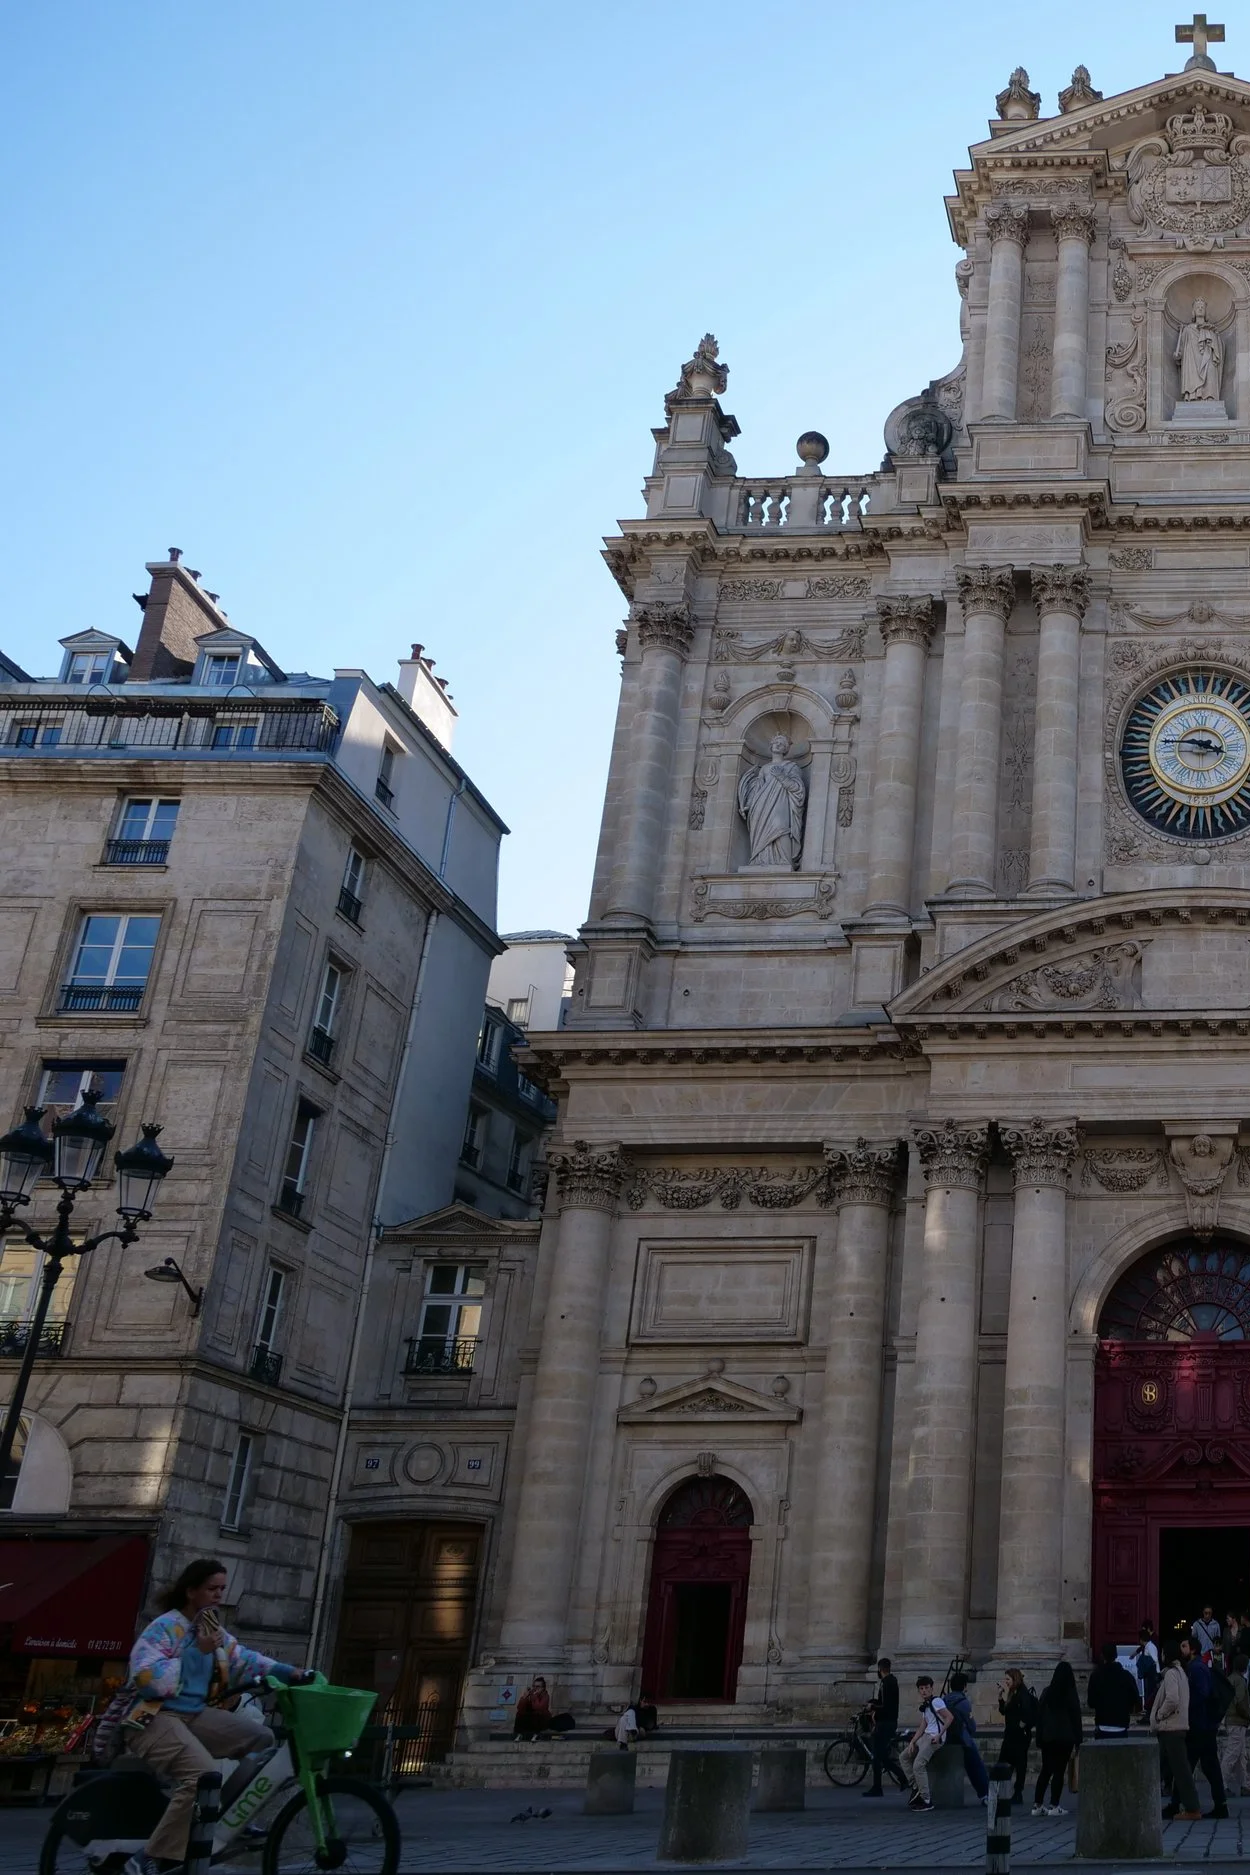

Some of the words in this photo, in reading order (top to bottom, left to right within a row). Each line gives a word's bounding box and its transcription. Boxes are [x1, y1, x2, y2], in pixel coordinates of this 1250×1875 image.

[1183, 696, 1217, 705] ANNO
[1193, 715, 1208, 726] XII
[367, 1459, 379, 1468] 97
[468, 1460, 480, 1469] 99
[223, 1775, 273, 1829] Lime
[66, 1809, 90, 1821] Lime
